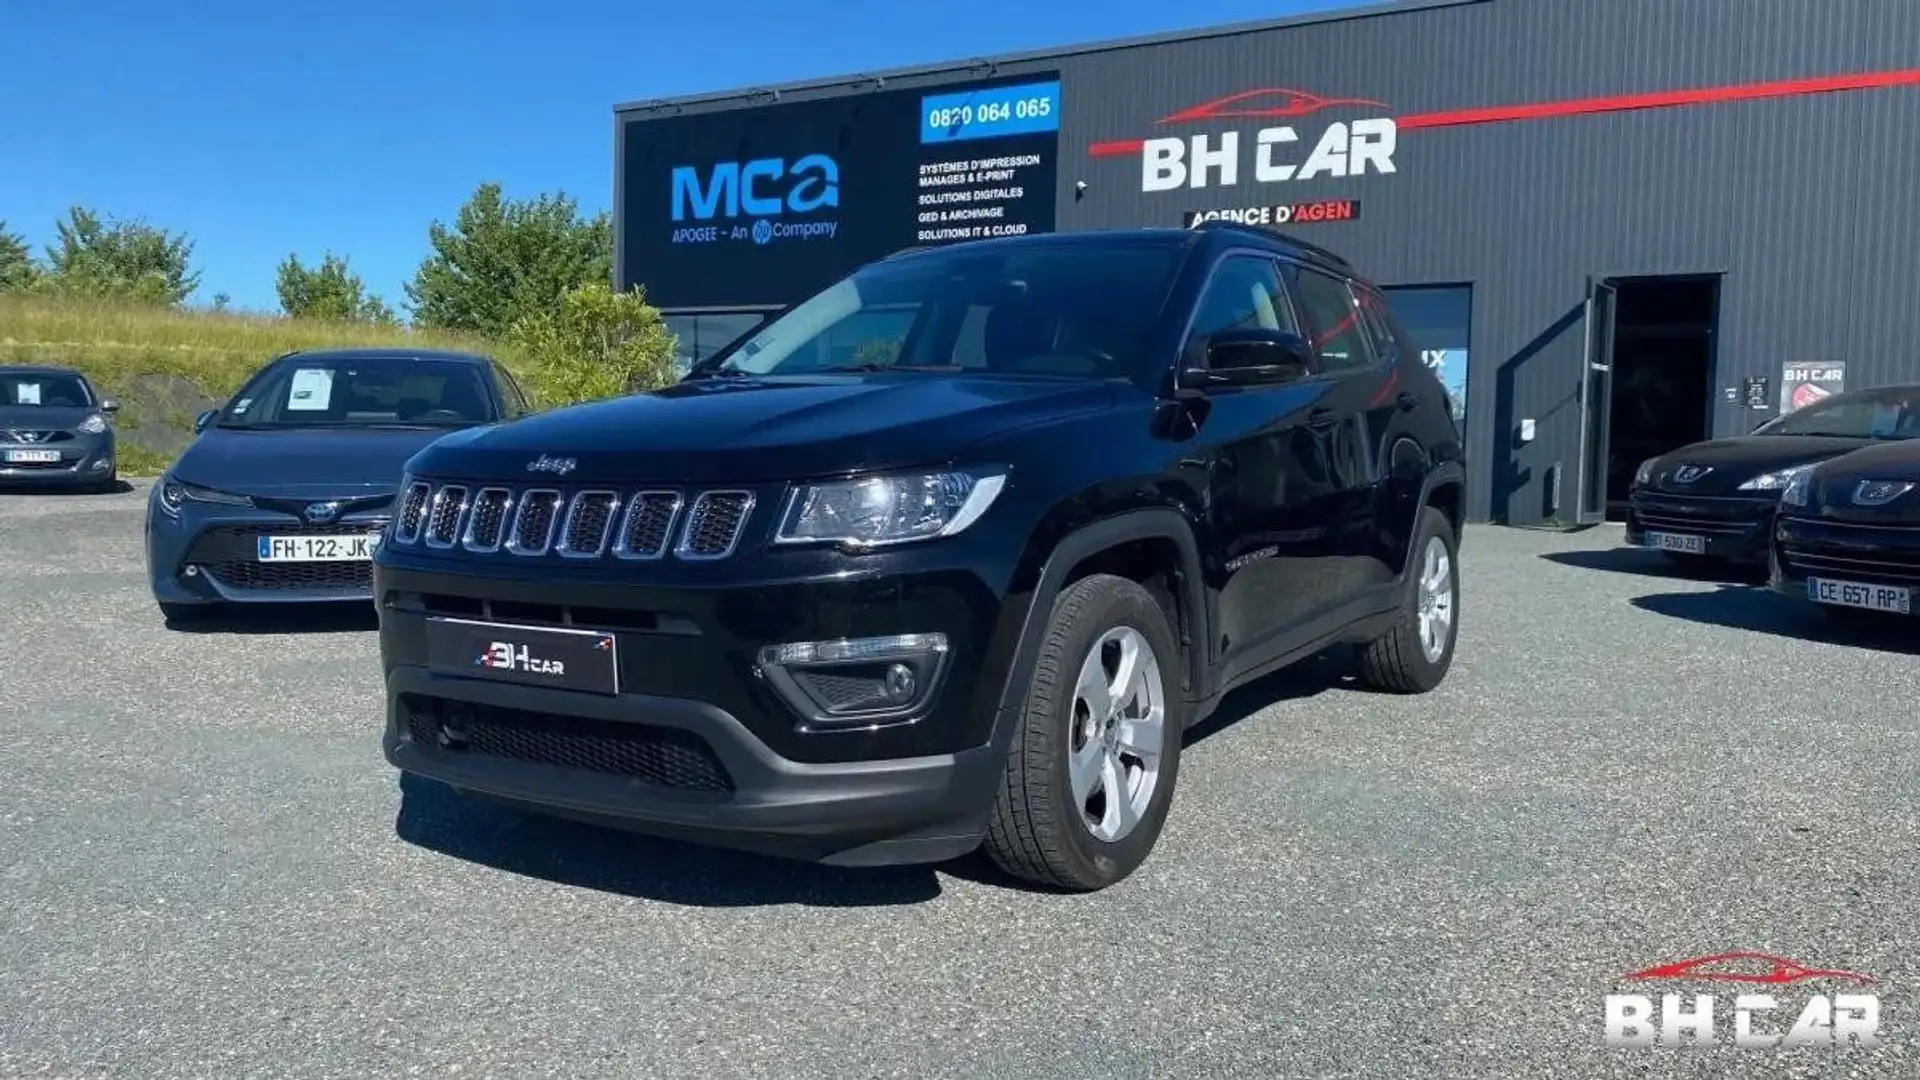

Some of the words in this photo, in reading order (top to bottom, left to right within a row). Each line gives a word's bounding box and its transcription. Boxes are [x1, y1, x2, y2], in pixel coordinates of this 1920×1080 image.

[929, 106, 973, 128] 0820
[977, 102, 1011, 123] 064
[1015, 96, 1051, 118] 065
[971, 155, 1040, 169] D'IMPRESSION
[1142, 131, 1239, 192] BH
[1254, 118, 1397, 183] CAR
[968, 172, 975, 183] &
[976, 169, 1016, 182] E-PRINT
[919, 191, 972, 205] SOLUTIONS
[973, 187, 1024, 201] DIGITALES
[918, 211, 939, 223] GED
[940, 211, 948, 221] &
[949, 207, 1004, 220] ARCHIVAGE
[1275, 201, 1351, 223] D'AGEN
[672, 227, 718, 243] APOGEE
[731, 225, 748, 240] An
[773, 221, 838, 240] Company
[918, 227, 971, 240] SOLUTIONS
[972, 226, 982, 237] IT
[983, 225, 991, 236] &
[992, 223, 1027, 236] CLOUD
[1784, 369, 1809, 381] BH
[1811, 369, 1842, 381] CAR
[527, 453, 577, 476] Jeep
[530, 658, 564, 675] CAR
